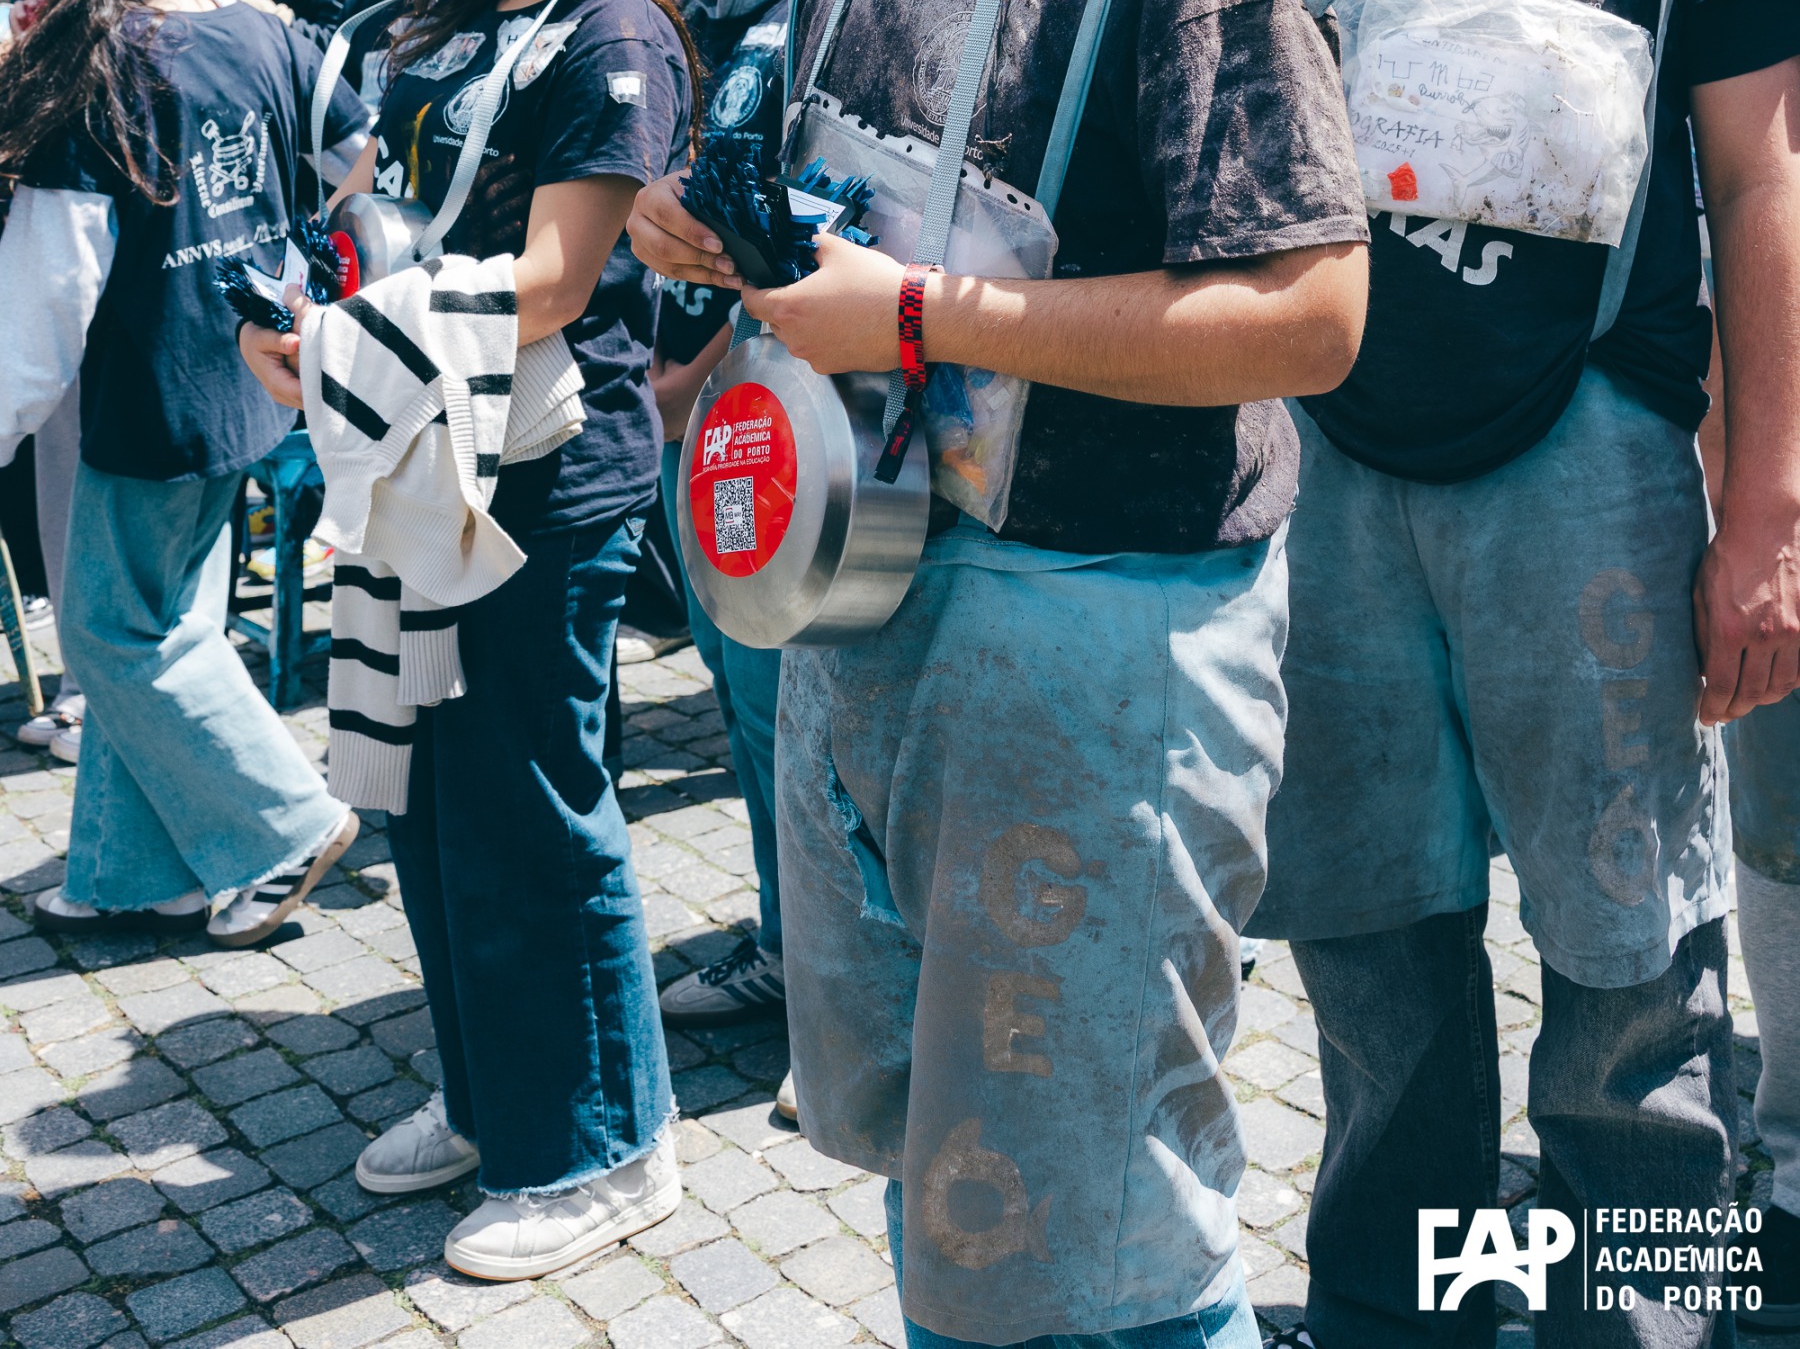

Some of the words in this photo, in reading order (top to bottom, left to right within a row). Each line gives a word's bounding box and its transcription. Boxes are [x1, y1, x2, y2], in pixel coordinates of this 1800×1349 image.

[743, 131, 764, 141] Porto
[900, 114, 940, 145] Universidade
[965, 145, 984, 161] orto
[1351, 111, 1445, 149] OGRAFIA
[161, 239, 223, 270] ANNVS
[735, 416, 772, 432] FEDERAÇÃO
[703, 424, 732, 466] FAP
[733, 449, 743, 459] DO
[746, 444, 771, 456] PORTO
[746, 455, 770, 465] EDUCAÇÃO
